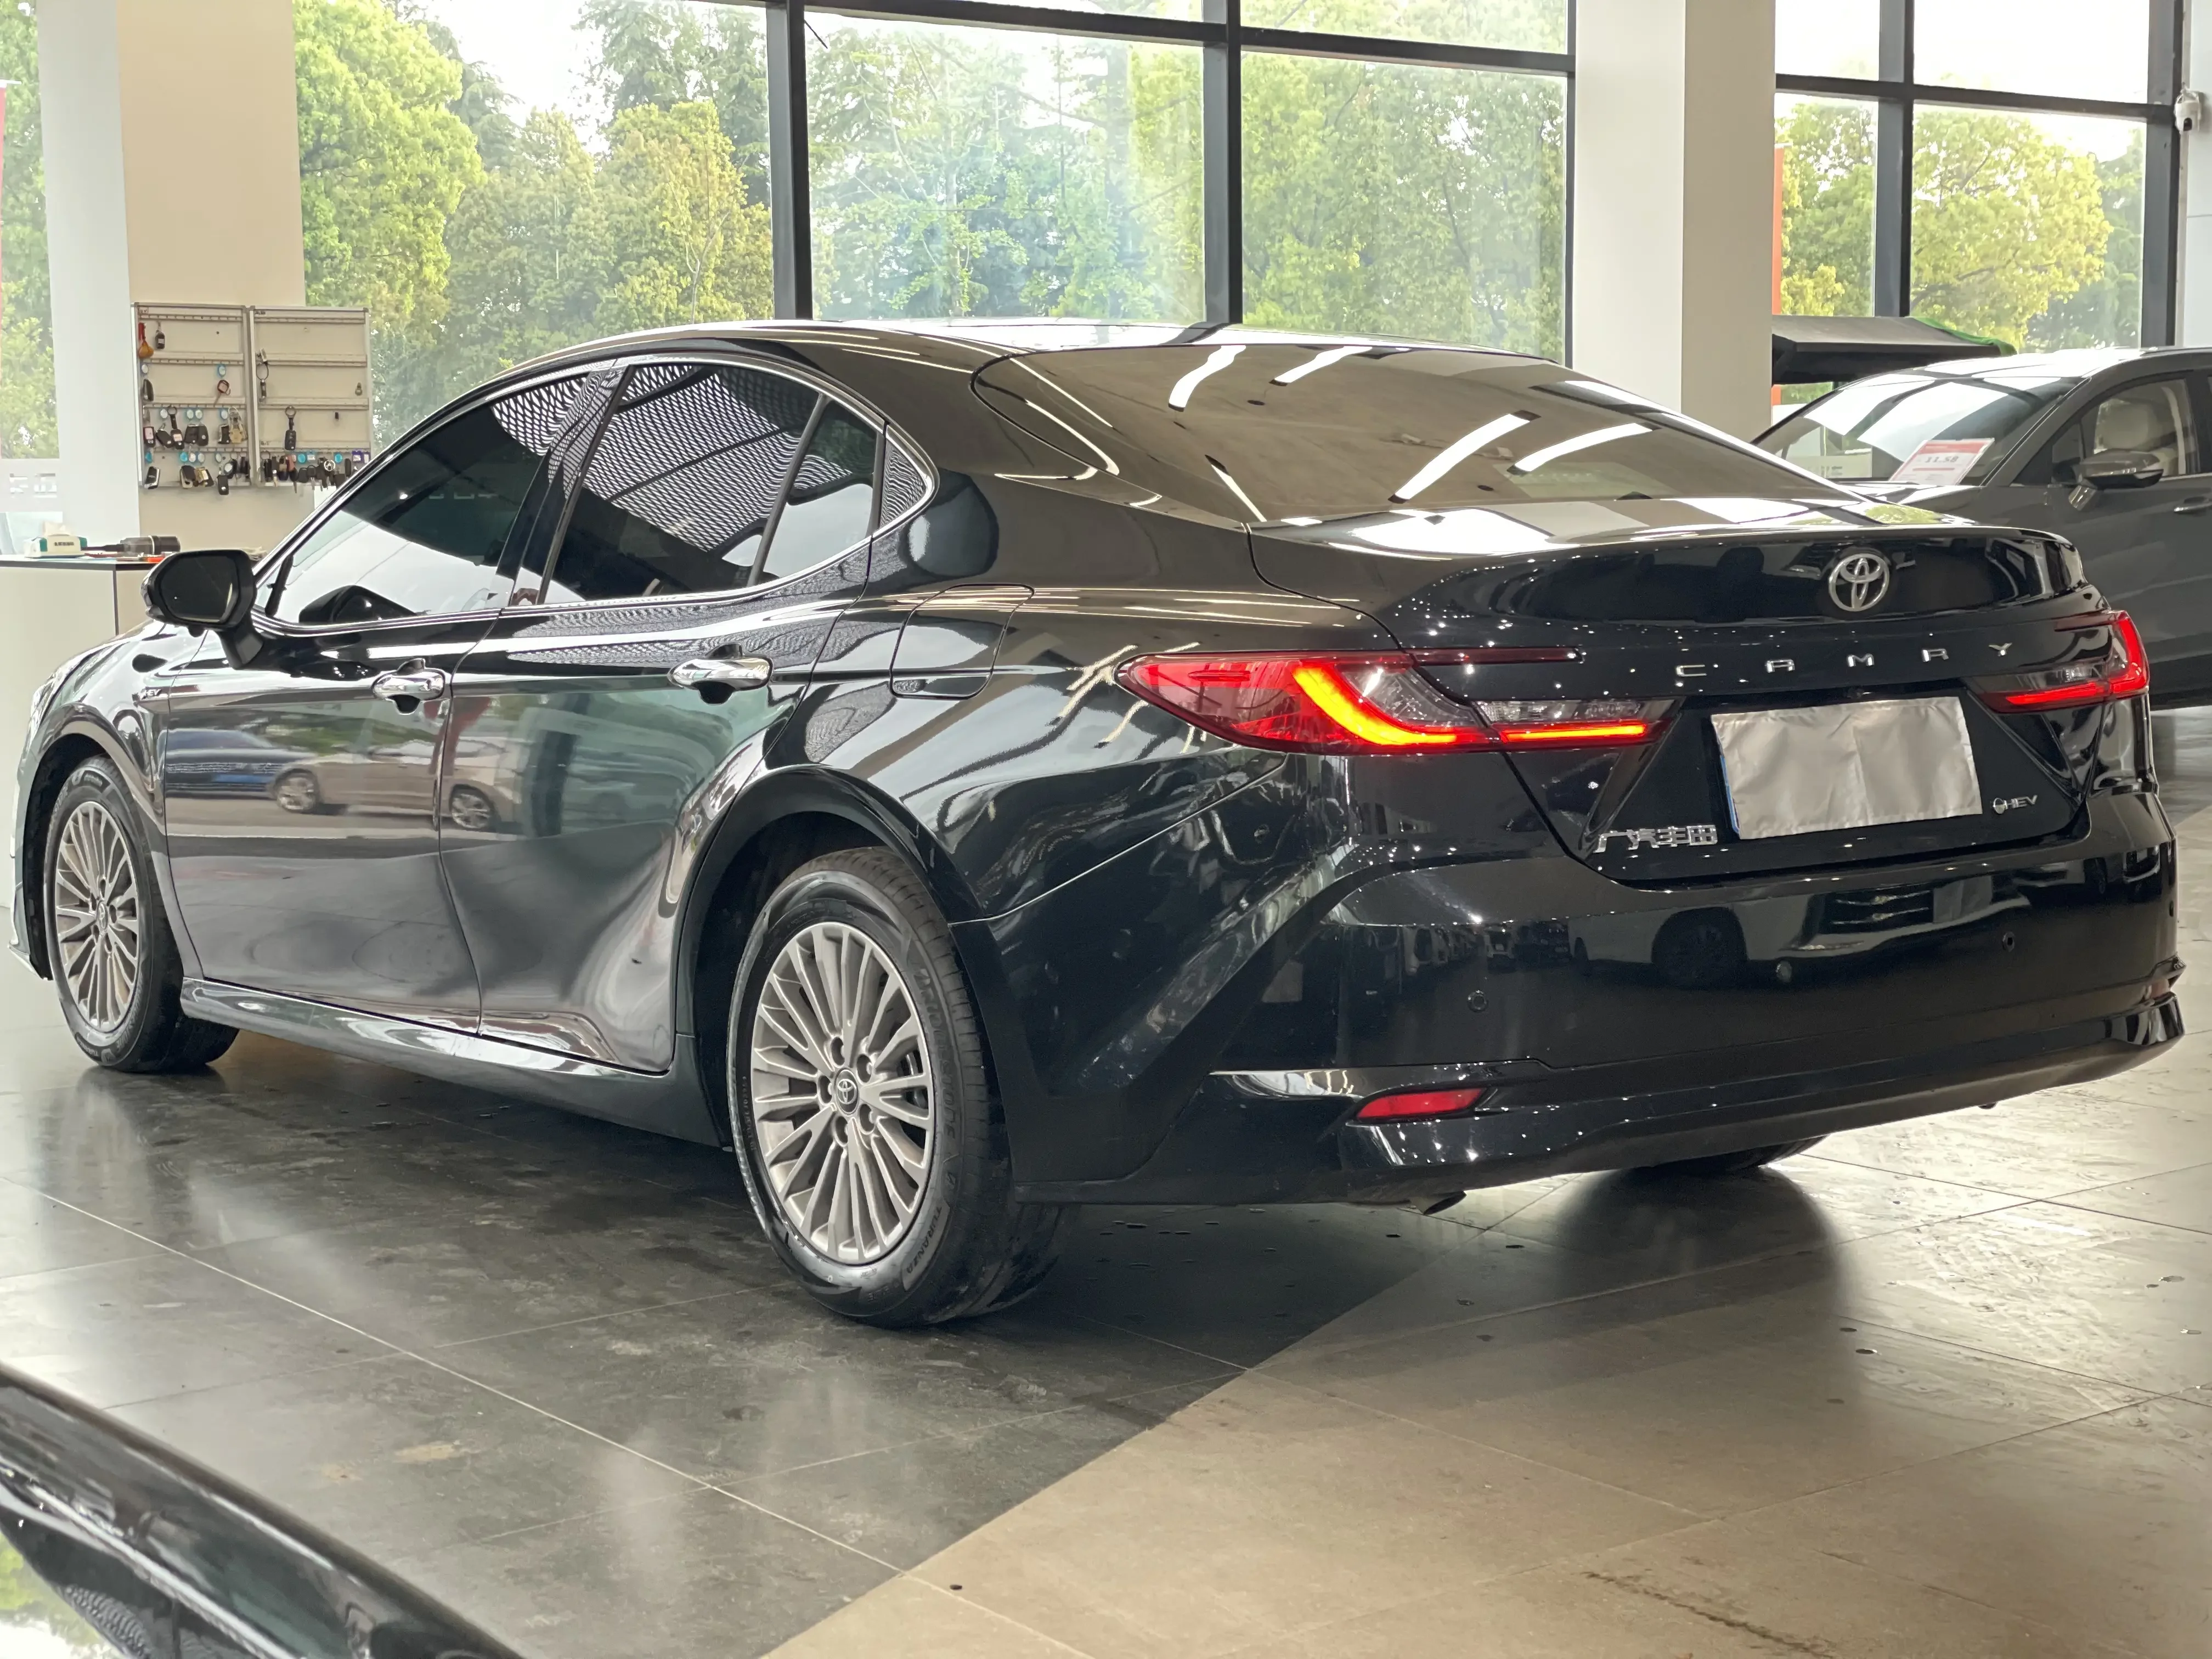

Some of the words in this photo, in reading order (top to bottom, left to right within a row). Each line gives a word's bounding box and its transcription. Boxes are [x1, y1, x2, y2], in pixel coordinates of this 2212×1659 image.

[1676, 642, 2012, 678] CAMRY
[2004, 794, 2038, 810] HEV
[1593, 825, 1718, 854] 广汽丰田
[906, 1206, 943, 1274] TURANZA
